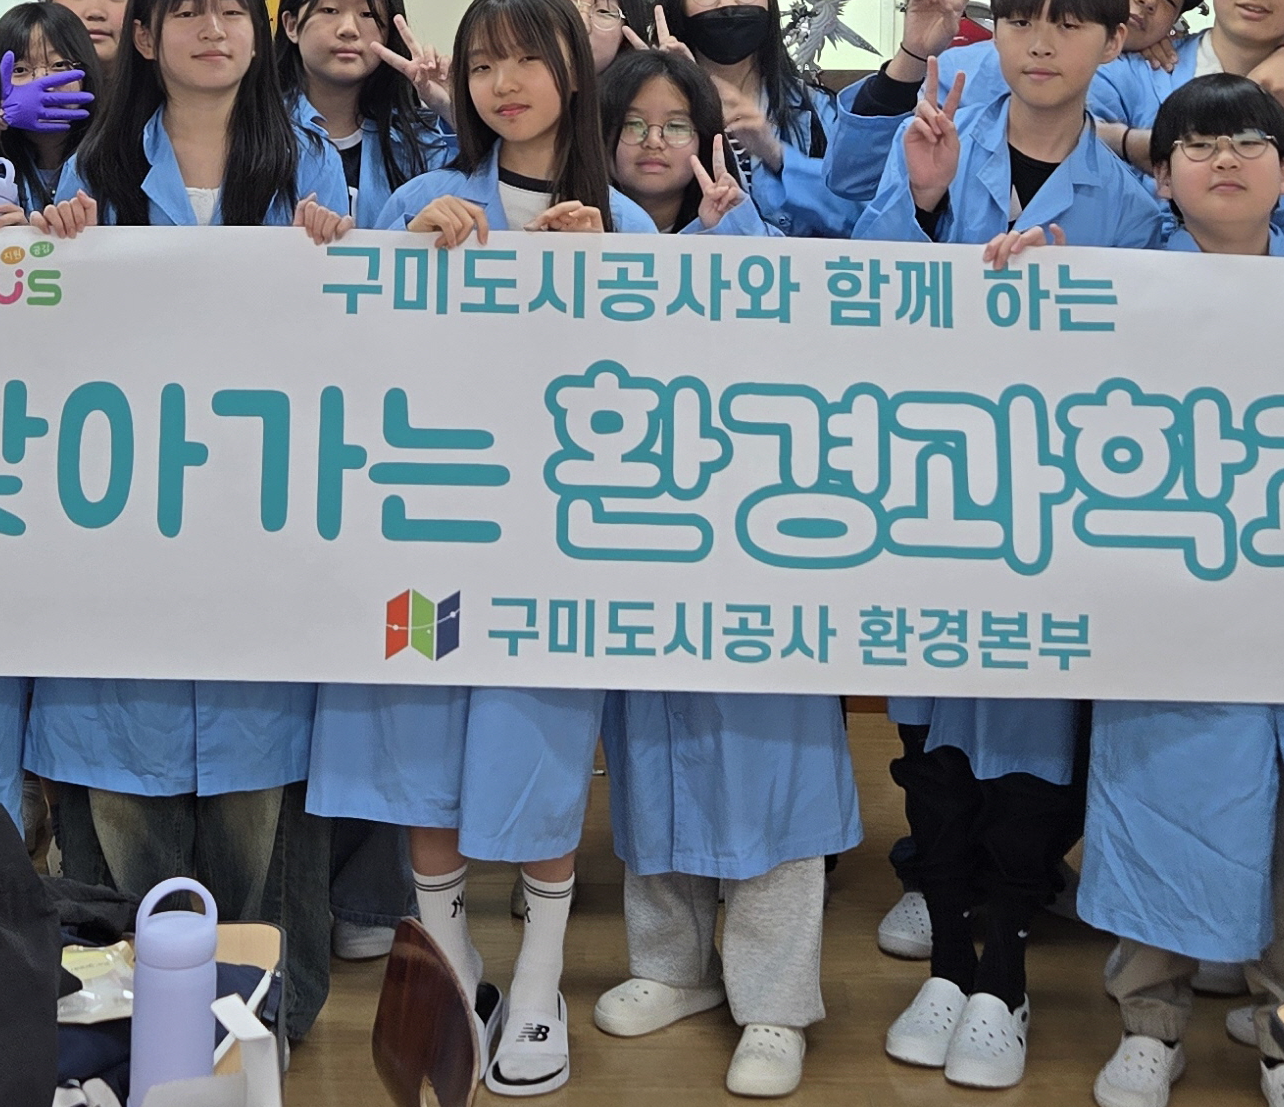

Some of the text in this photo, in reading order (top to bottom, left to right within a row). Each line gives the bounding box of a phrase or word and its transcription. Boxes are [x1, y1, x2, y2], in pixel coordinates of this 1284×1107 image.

[323, 248, 1117, 332] 구미도시공사와 함께 하는
[488, 597, 1092, 671] 구미도시공사 환경본부
